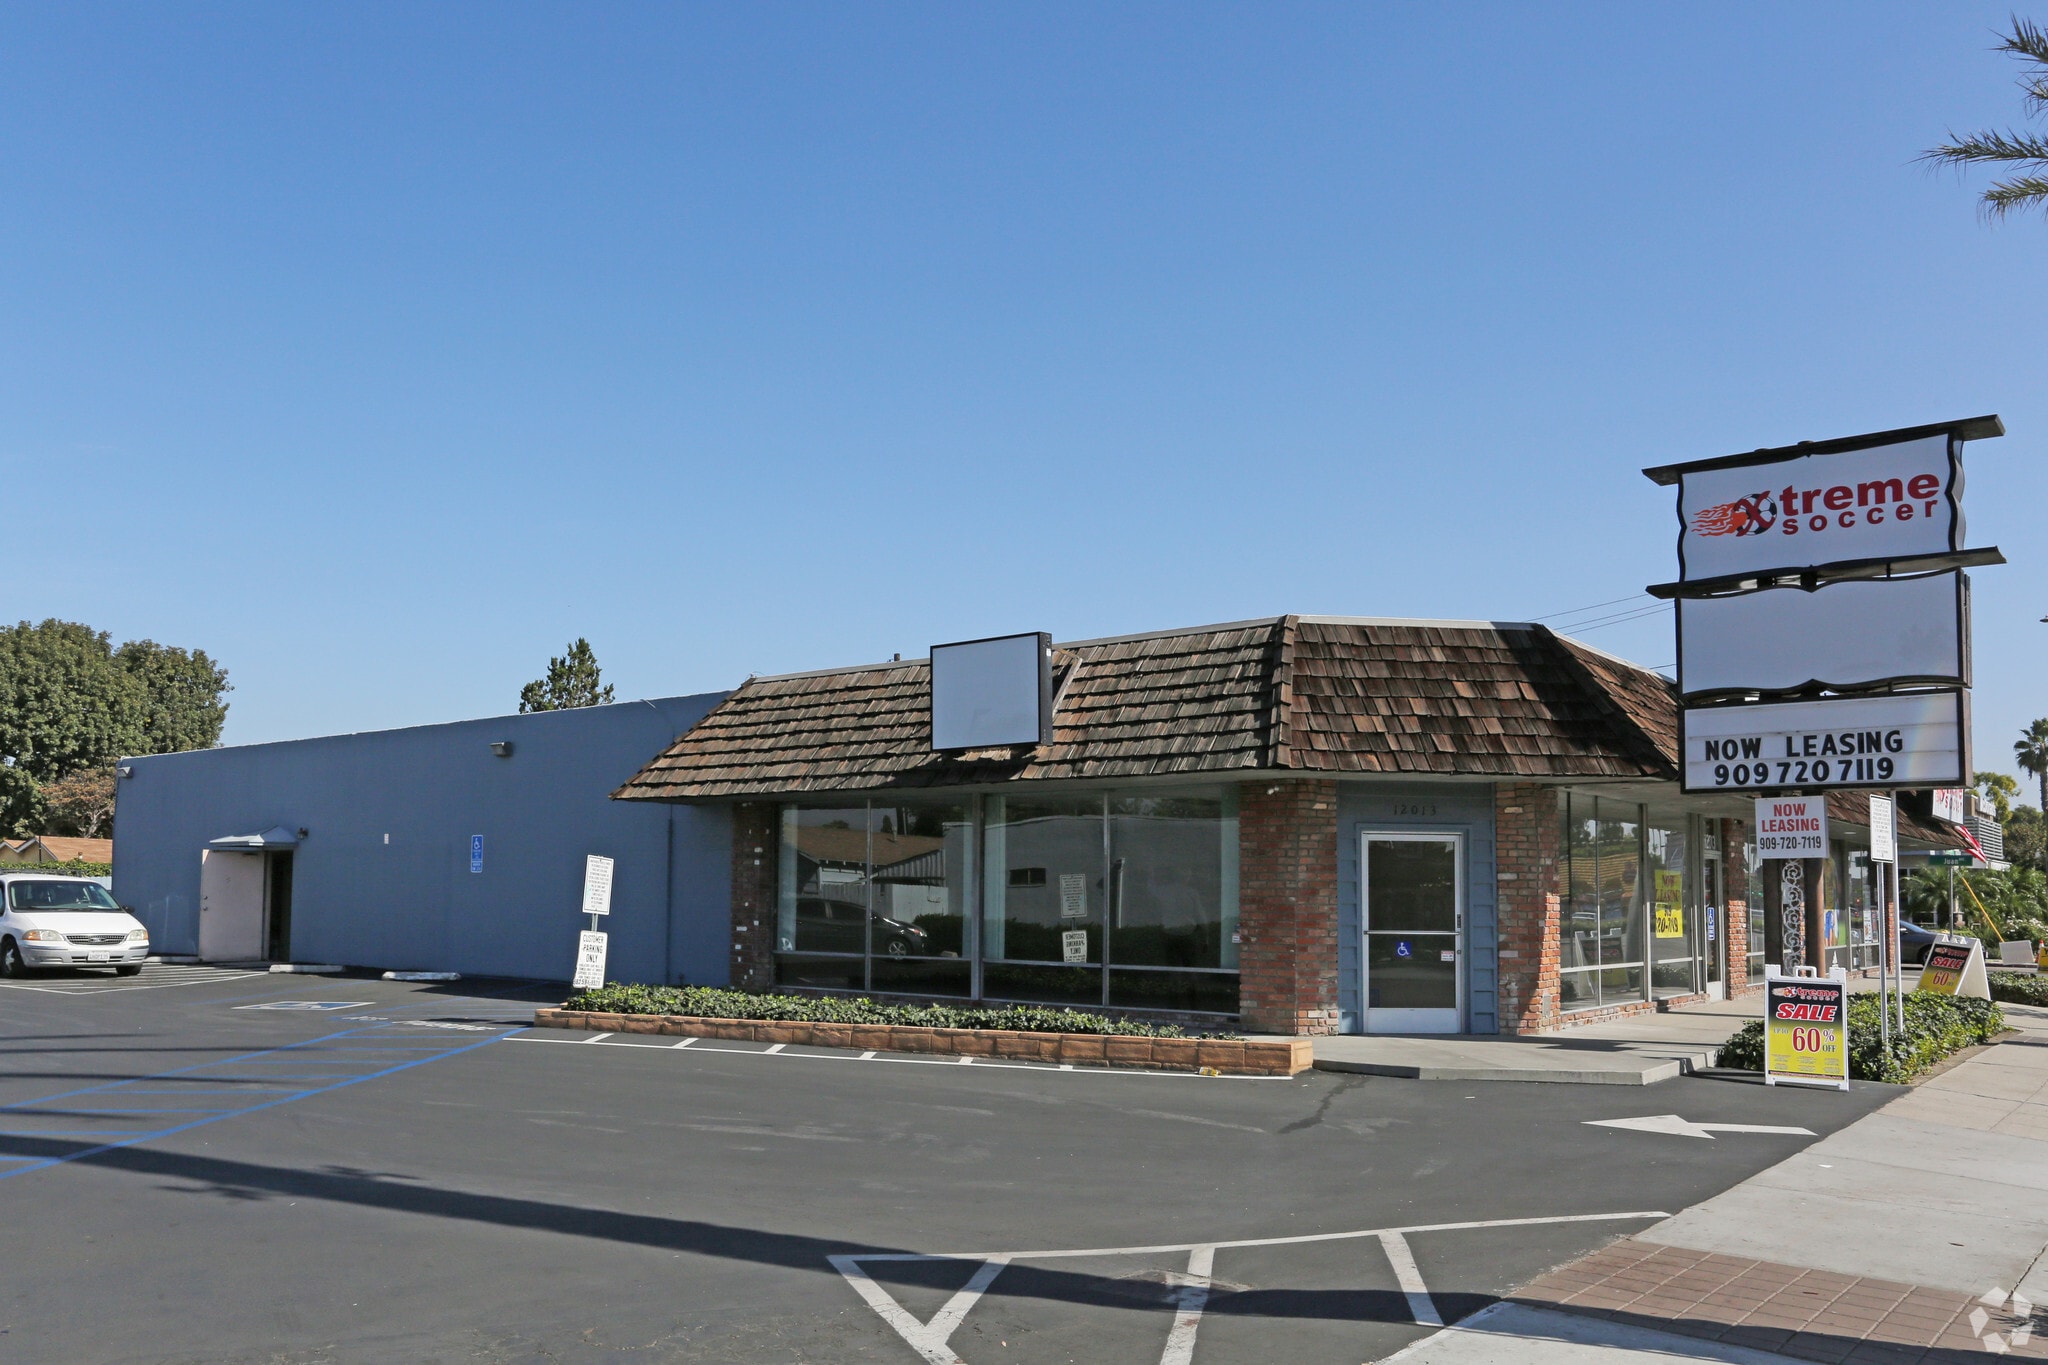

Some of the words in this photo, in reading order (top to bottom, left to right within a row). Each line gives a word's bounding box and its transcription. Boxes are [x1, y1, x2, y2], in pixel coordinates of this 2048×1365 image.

[1782, 499, 1937, 536] soccer
[1705, 737, 1762, 761] NOW
[1786, 730, 1903, 758] LEASING
[1714, 762, 1769, 786] 909
[1776, 760, 1830, 784] 720
[1838, 757, 1894, 781] 7119
[1393, 804, 1437, 816] 12013
[1773, 803, 1806, 817] NOW
[1761, 818, 1820, 833] LEASING
[1760, 836, 1822, 850] 909-720-7119
[1943, 857, 1959, 865] Juan
[583, 934, 604, 944] CUSTOMER
[583, 944, 603, 954] PARKING
[585, 953, 598, 963] ONLY
[1931, 956, 1965, 970] SALE
[1776, 1003, 1838, 1022] SALE
[1822, 1044, 1836, 1053] OFF
